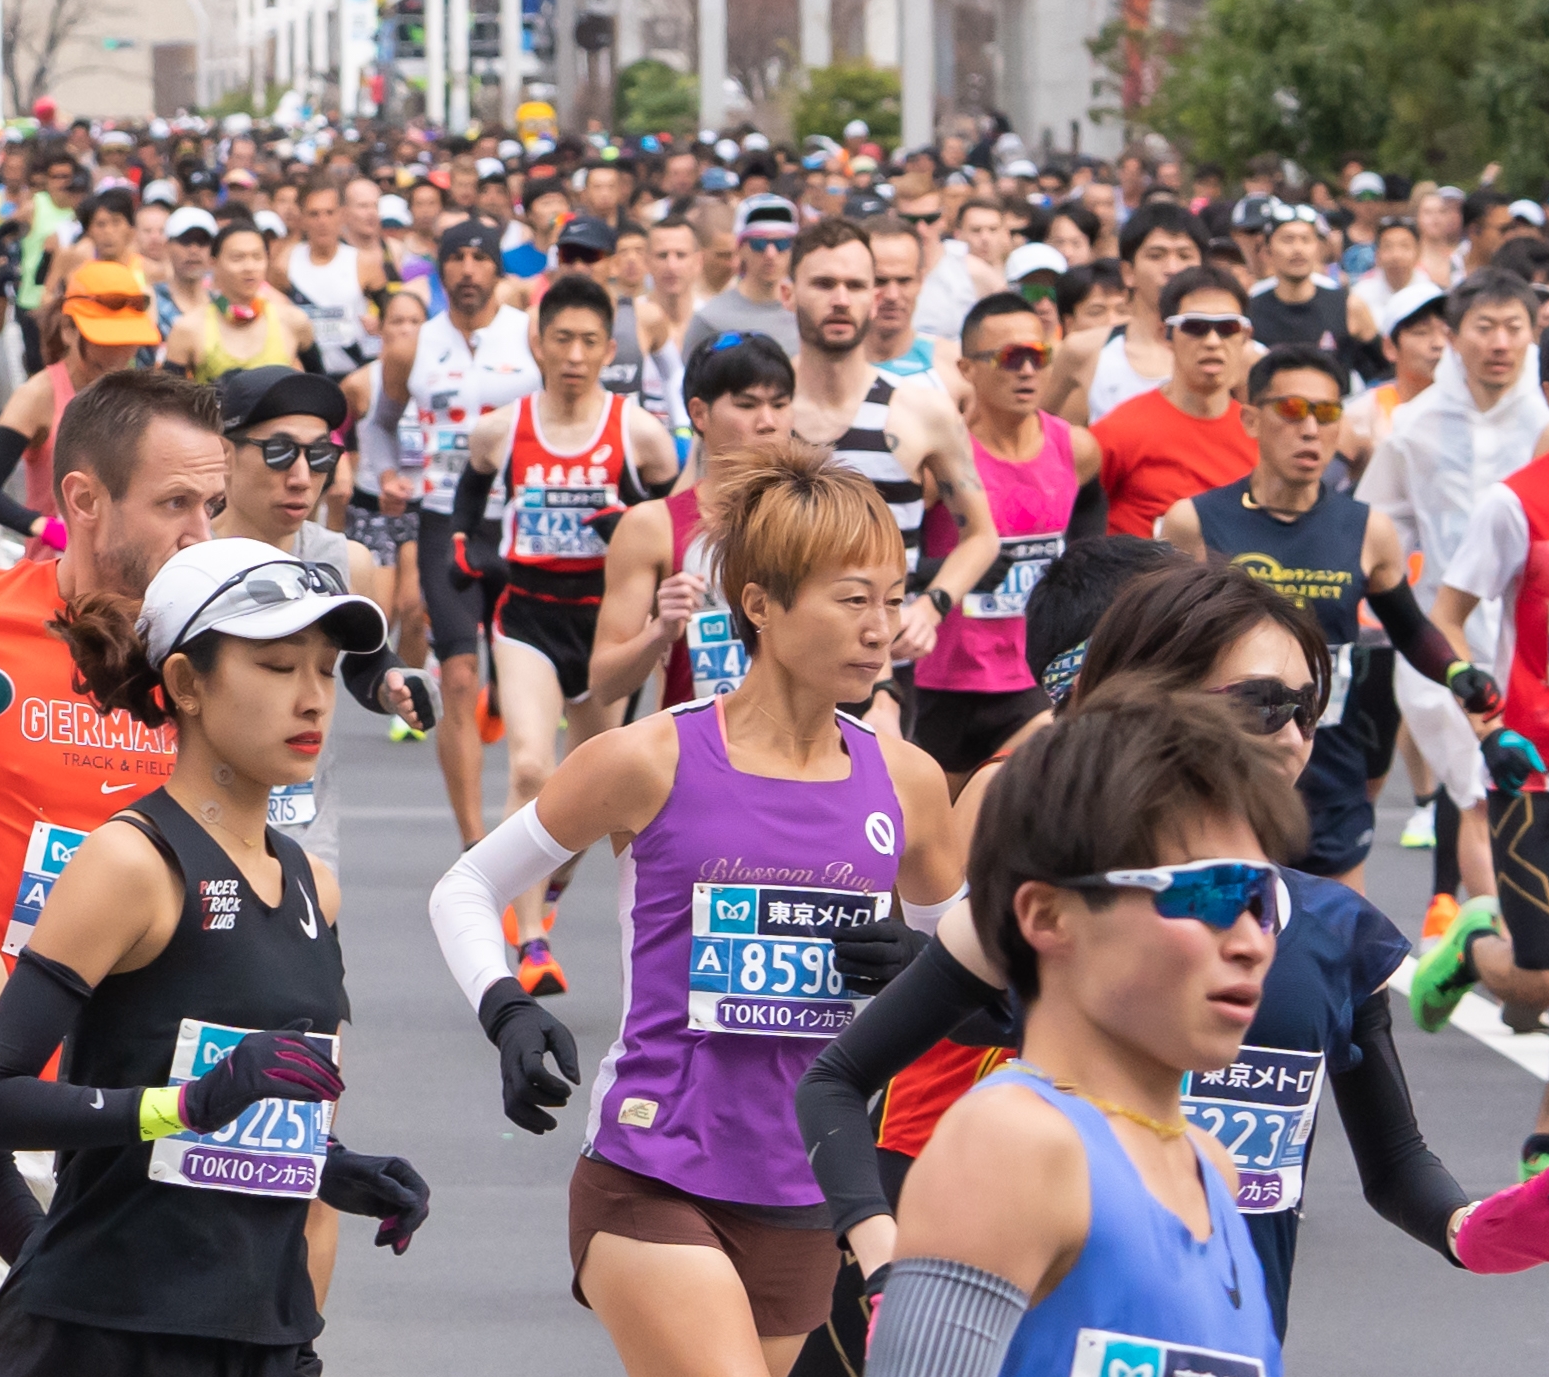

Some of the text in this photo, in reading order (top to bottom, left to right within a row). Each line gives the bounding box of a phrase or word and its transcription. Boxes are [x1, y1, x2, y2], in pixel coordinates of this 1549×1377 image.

[63, 753, 113, 771] TRACK
[120, 757, 130, 771] &
[268, 796, 296, 822] RTS
[699, 858, 813, 883] Blossom
[23, 882, 46, 907] A
[200, 879, 239, 896] PACER
[202, 897, 242, 913] TRACK
[767, 901, 870, 927] 東京メトロ
[203, 913, 236, 930] CLUB
[699, 942, 844, 995] A 8598
[1201, 1063, 1314, 1094] 東京メトロ
[1182, 1106, 1287, 1164] 223
